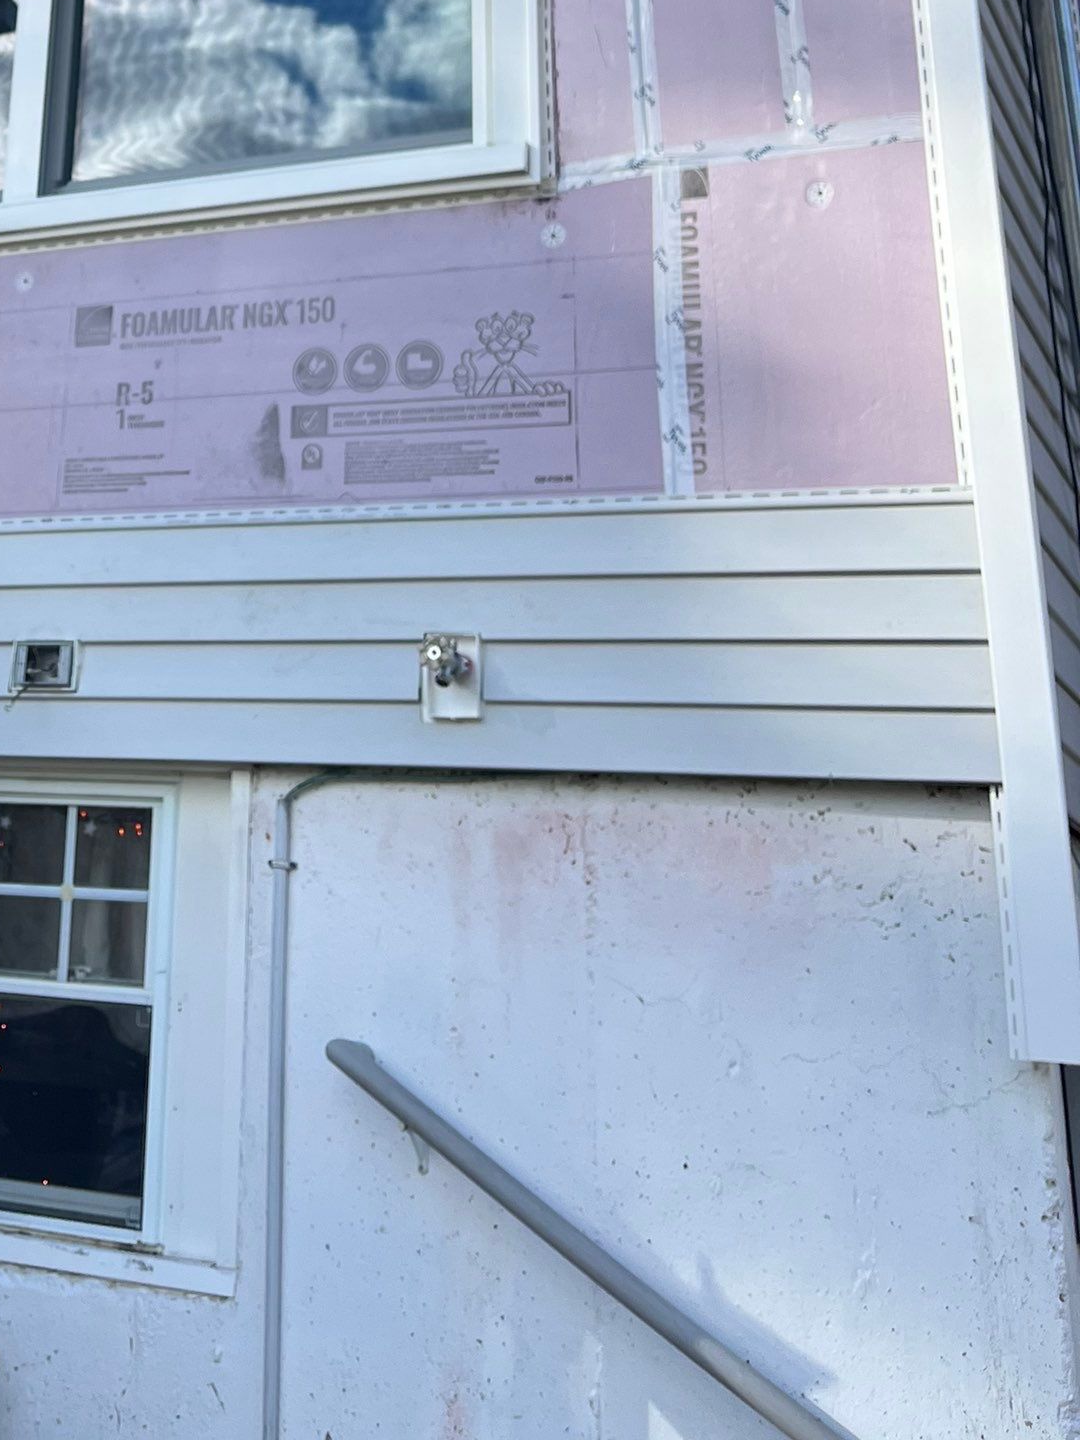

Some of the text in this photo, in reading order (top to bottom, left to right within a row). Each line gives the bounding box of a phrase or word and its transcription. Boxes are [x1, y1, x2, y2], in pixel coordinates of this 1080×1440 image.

[120, 304, 236, 339] FOAMULAR
[296, 295, 336, 325] 150
[115, 380, 154, 407] R-5
[116, 408, 125, 430] 1
